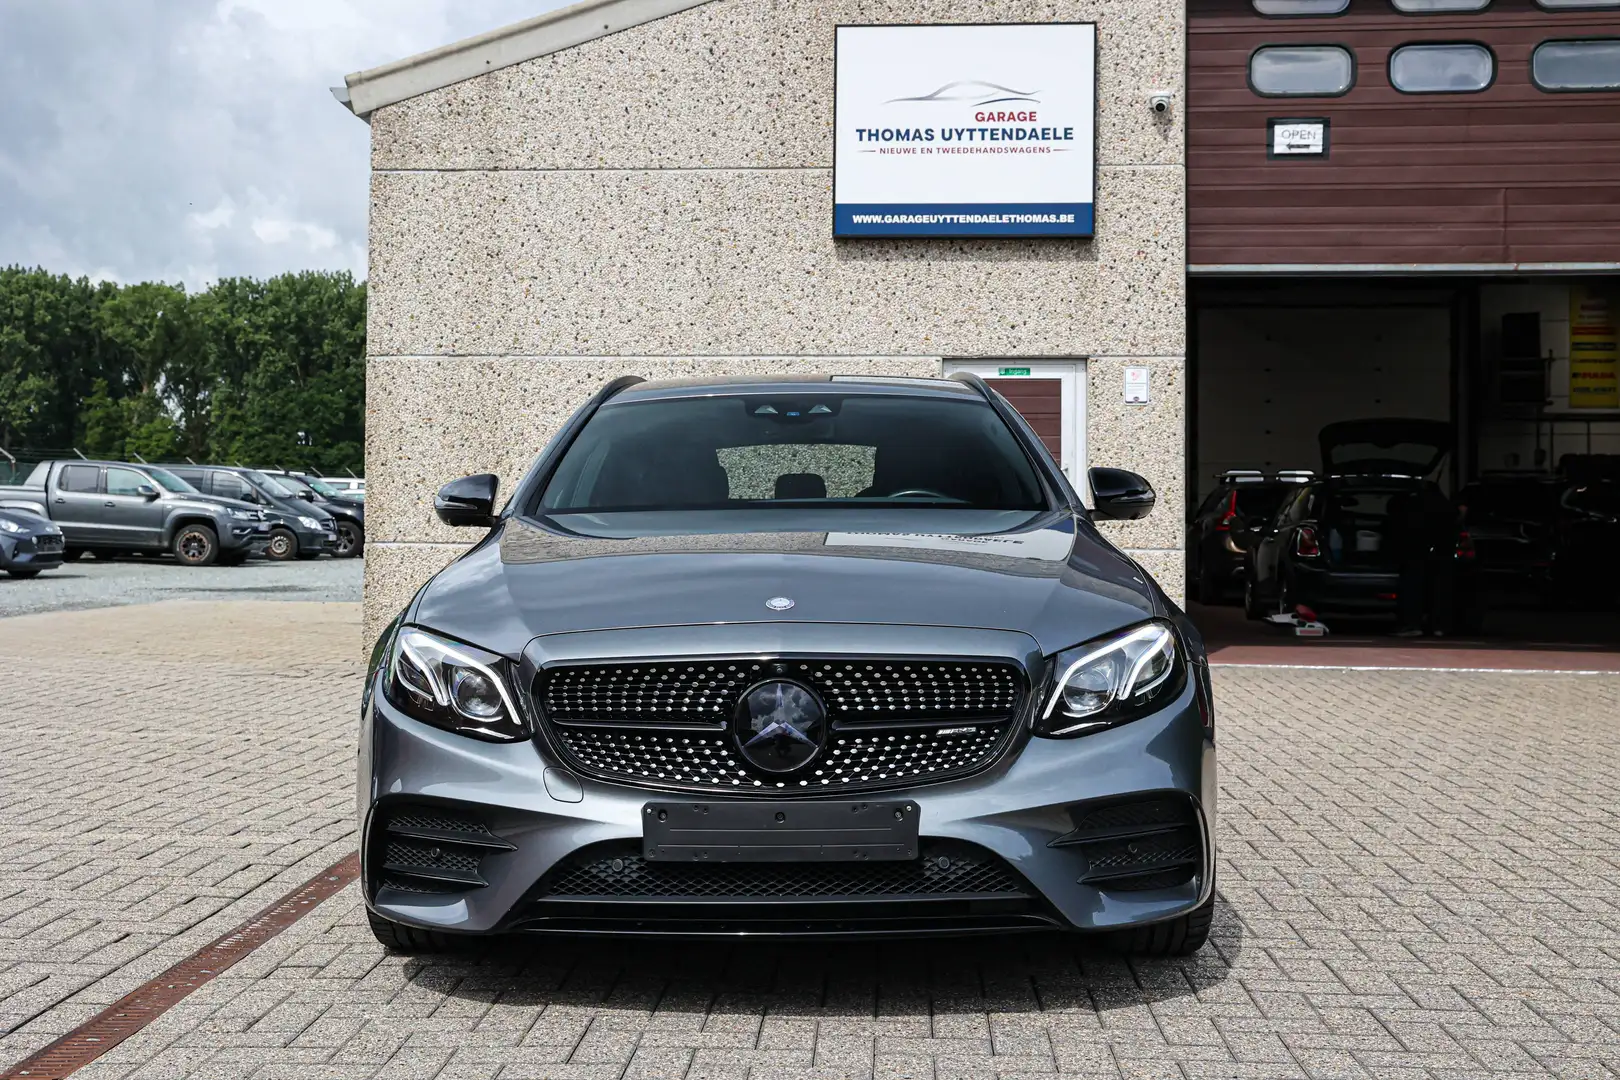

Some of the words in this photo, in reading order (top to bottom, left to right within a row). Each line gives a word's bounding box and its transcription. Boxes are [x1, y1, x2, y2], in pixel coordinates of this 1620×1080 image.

[975, 111, 1037, 122] GARAGE
[856, 128, 934, 141] THOMAS
[941, 127, 1073, 141] UYTTENDAELE
[1281, 129, 1316, 140] OPEN
[936, 146, 1051, 154] TWEEDEHANDSWAGENS
[852, 214, 1075, 224] WWW.GARAGEUYTTENDAELETHOMAS.BE
